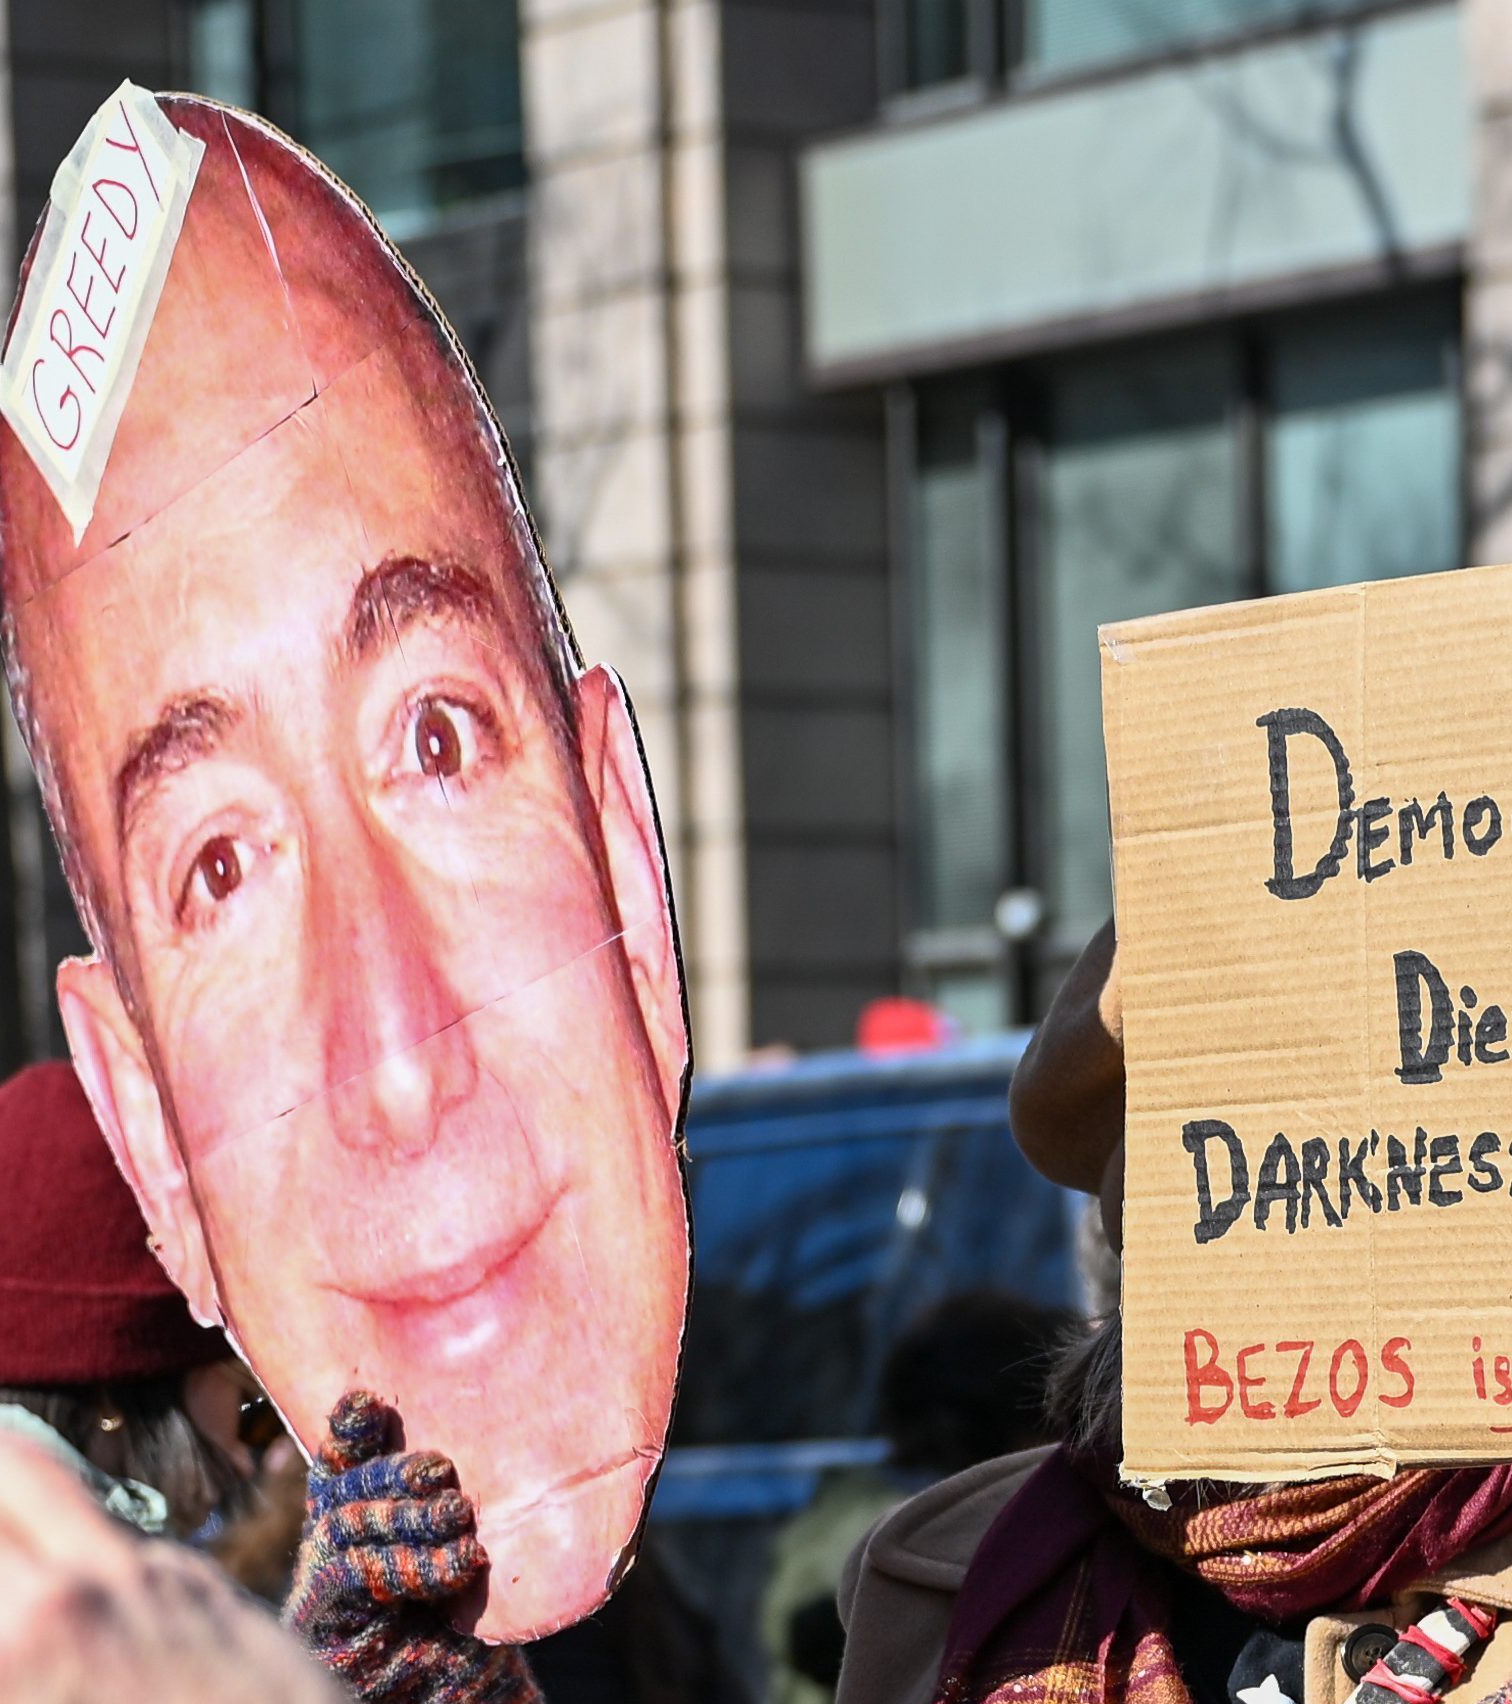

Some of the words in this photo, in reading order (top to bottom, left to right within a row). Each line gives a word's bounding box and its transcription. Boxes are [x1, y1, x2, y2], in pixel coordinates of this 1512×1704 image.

[32, 100, 164, 450] GREEDY
[1184, 1328, 1416, 1424] BEZOS
[1472, 1335, 1512, 1404] is
